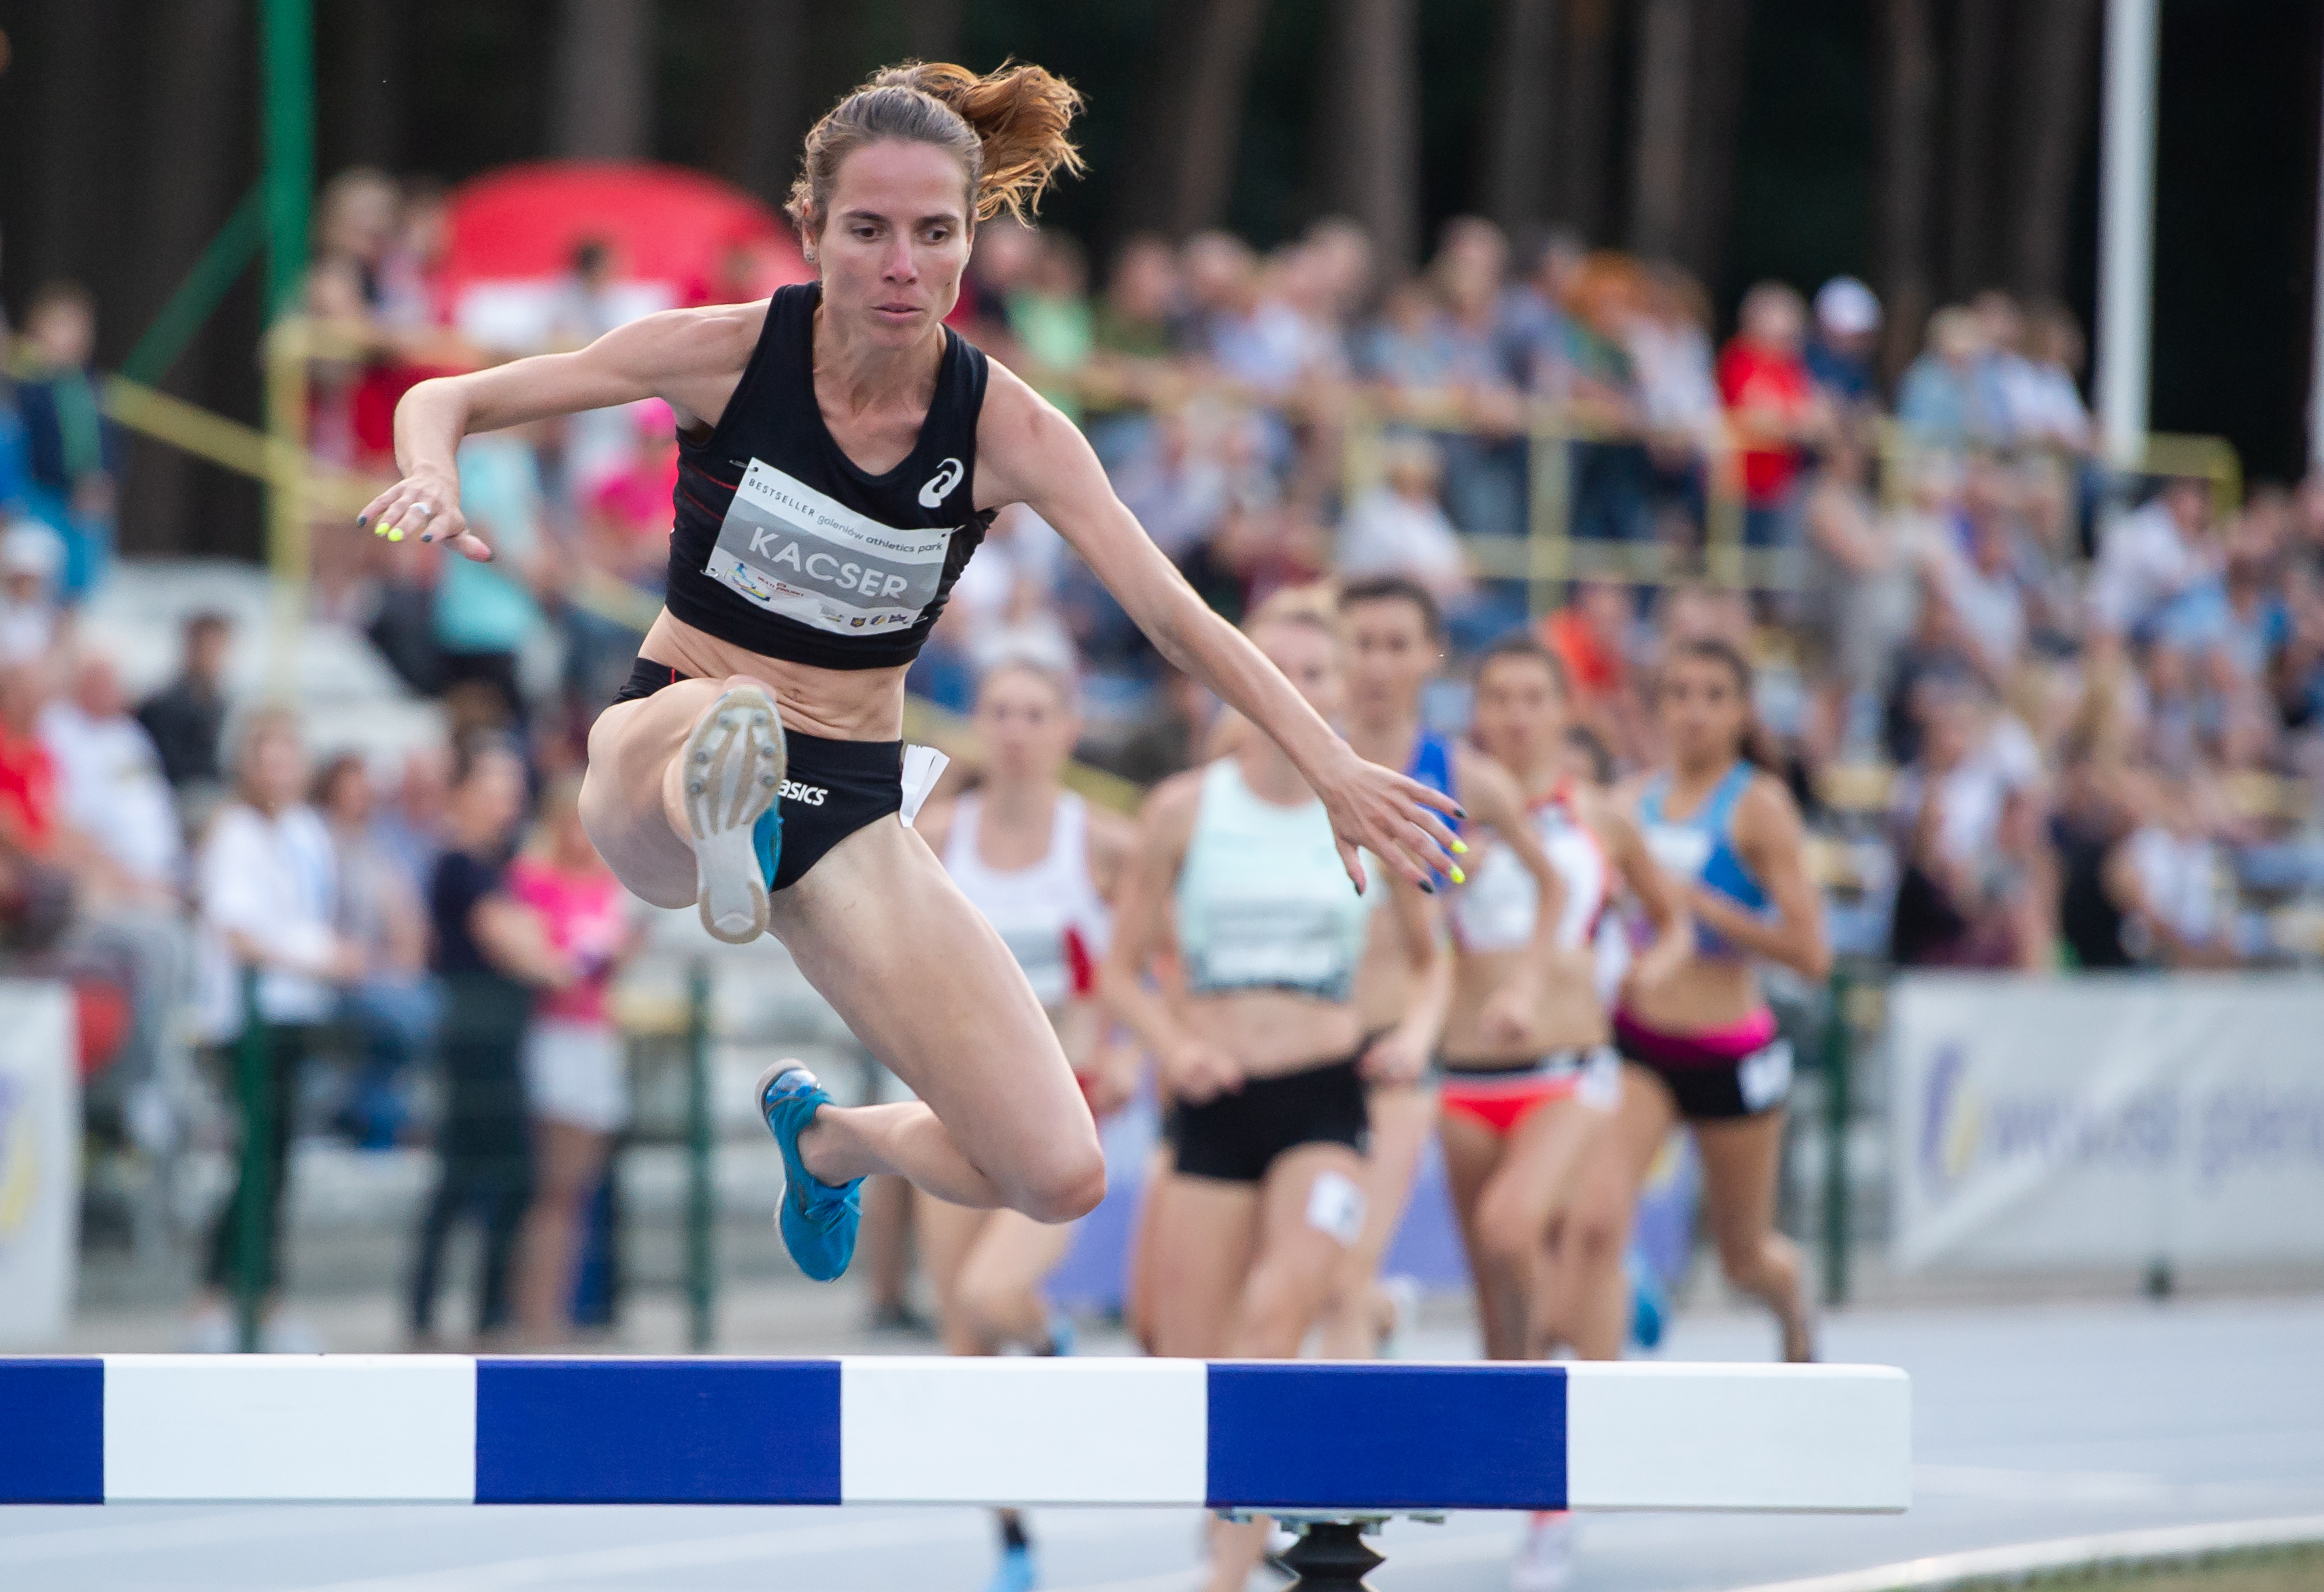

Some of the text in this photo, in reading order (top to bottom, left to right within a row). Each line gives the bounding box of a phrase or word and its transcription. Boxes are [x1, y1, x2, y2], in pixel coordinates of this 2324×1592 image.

[749, 478, 942, 555] BESTSELLER goleniów athletics park
[749, 526, 908, 599] KACSER
